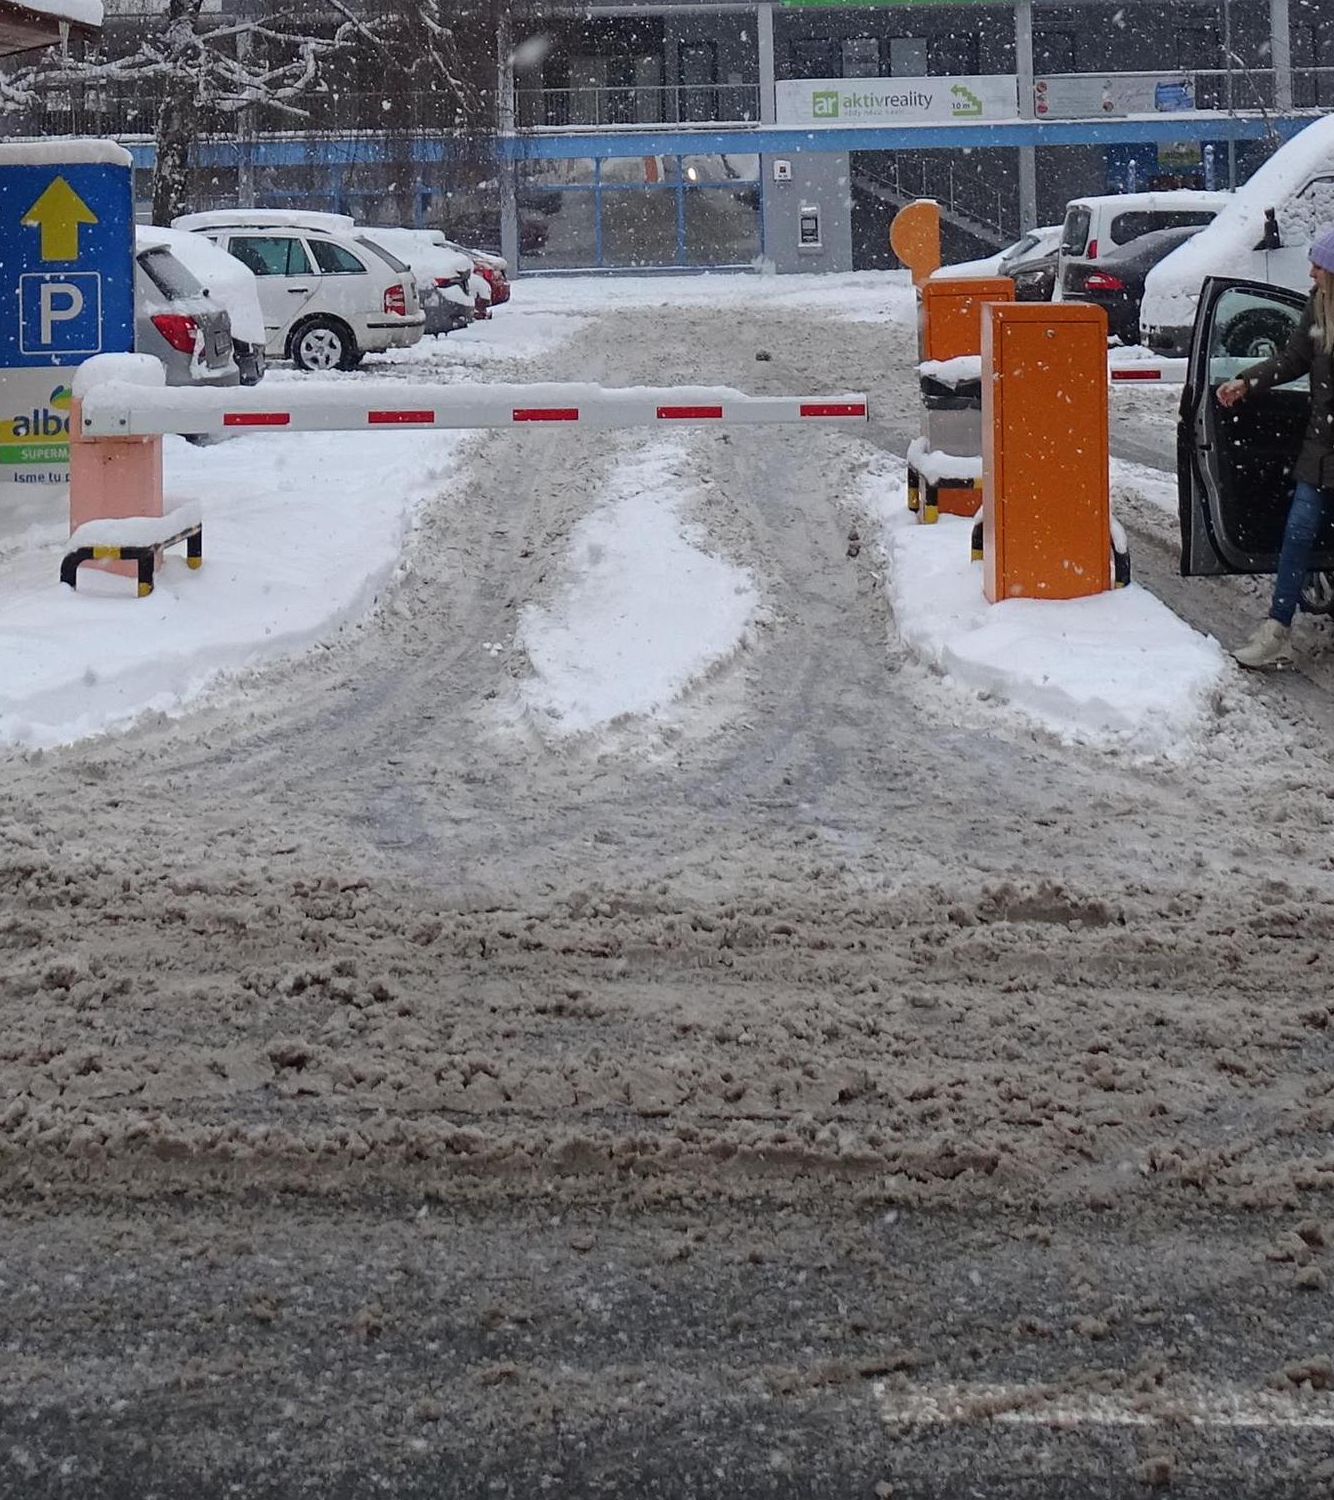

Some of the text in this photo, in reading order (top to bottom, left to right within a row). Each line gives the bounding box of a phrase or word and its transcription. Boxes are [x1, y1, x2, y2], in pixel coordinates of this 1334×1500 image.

[842, 91, 933, 110] aktivreality
[952, 102, 962, 110] 10
[41, 283, 84, 344] P
